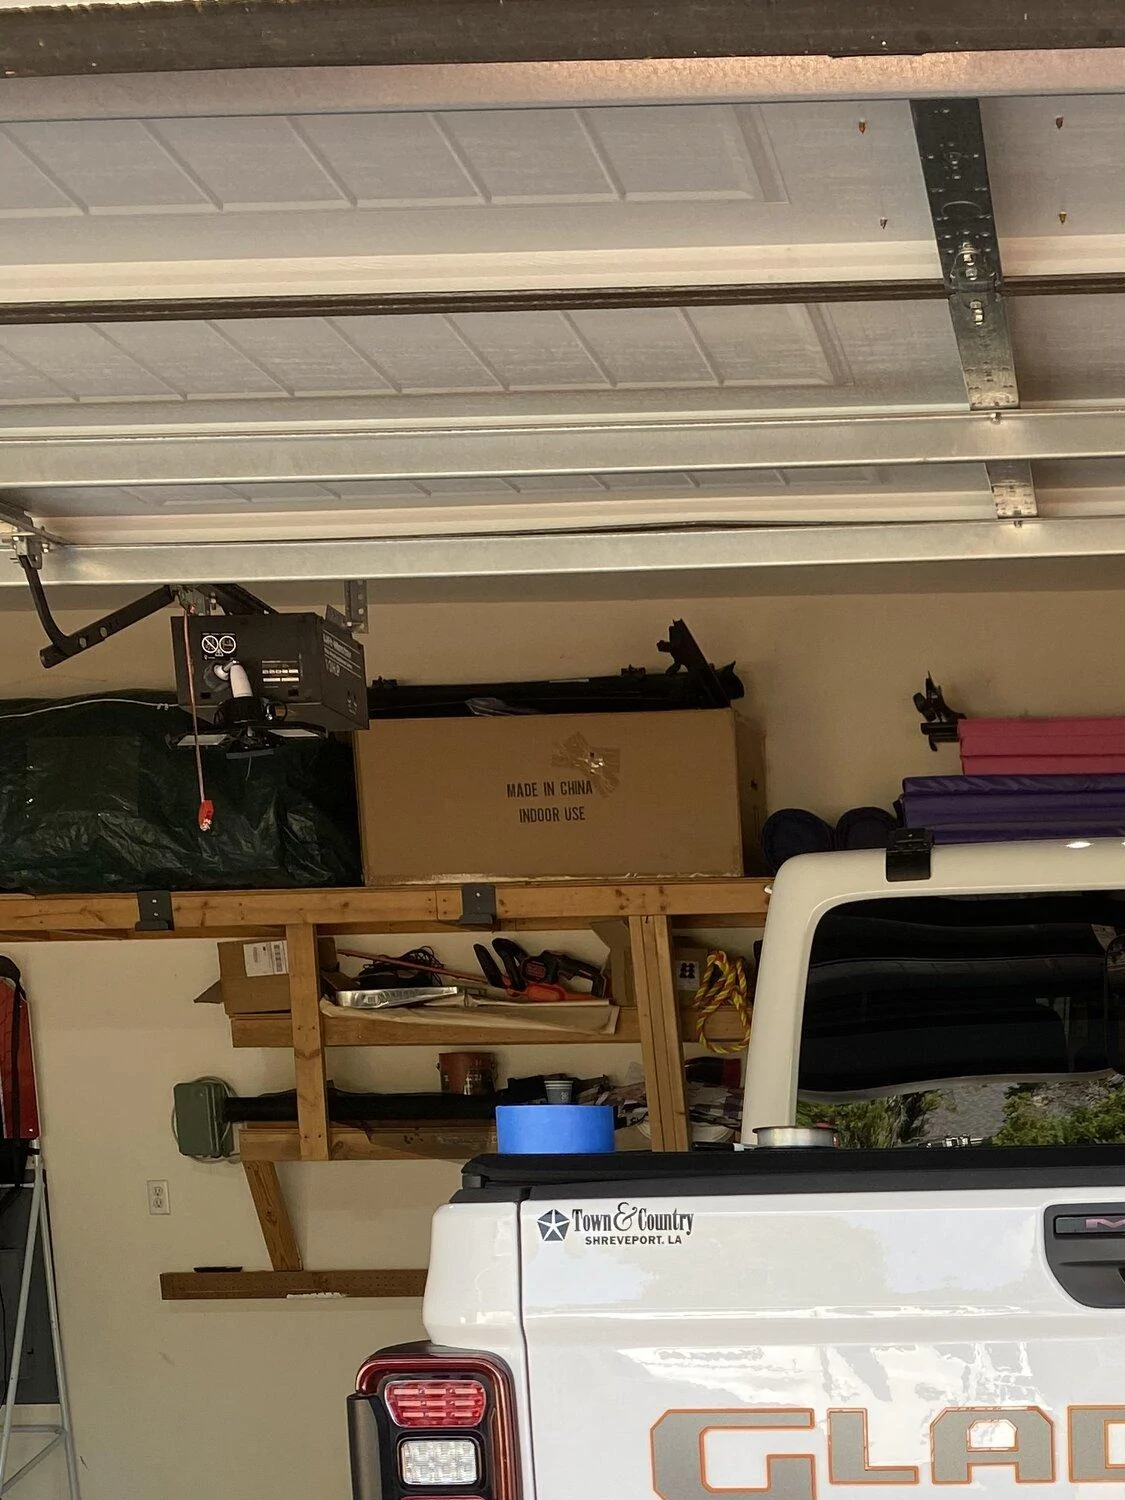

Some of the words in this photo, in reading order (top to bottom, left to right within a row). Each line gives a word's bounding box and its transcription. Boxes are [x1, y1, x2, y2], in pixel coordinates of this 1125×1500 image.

[506, 782, 538, 798] MADE
[543, 781, 555, 796] IN
[560, 780, 593, 796] CHINA
[519, 807, 560, 823] INDOOR
[564, 806, 586, 821] USE
[571, 1208, 612, 1232] Town
[637, 1207, 695, 1236] Country
[668, 1235, 683, 1245] LA
